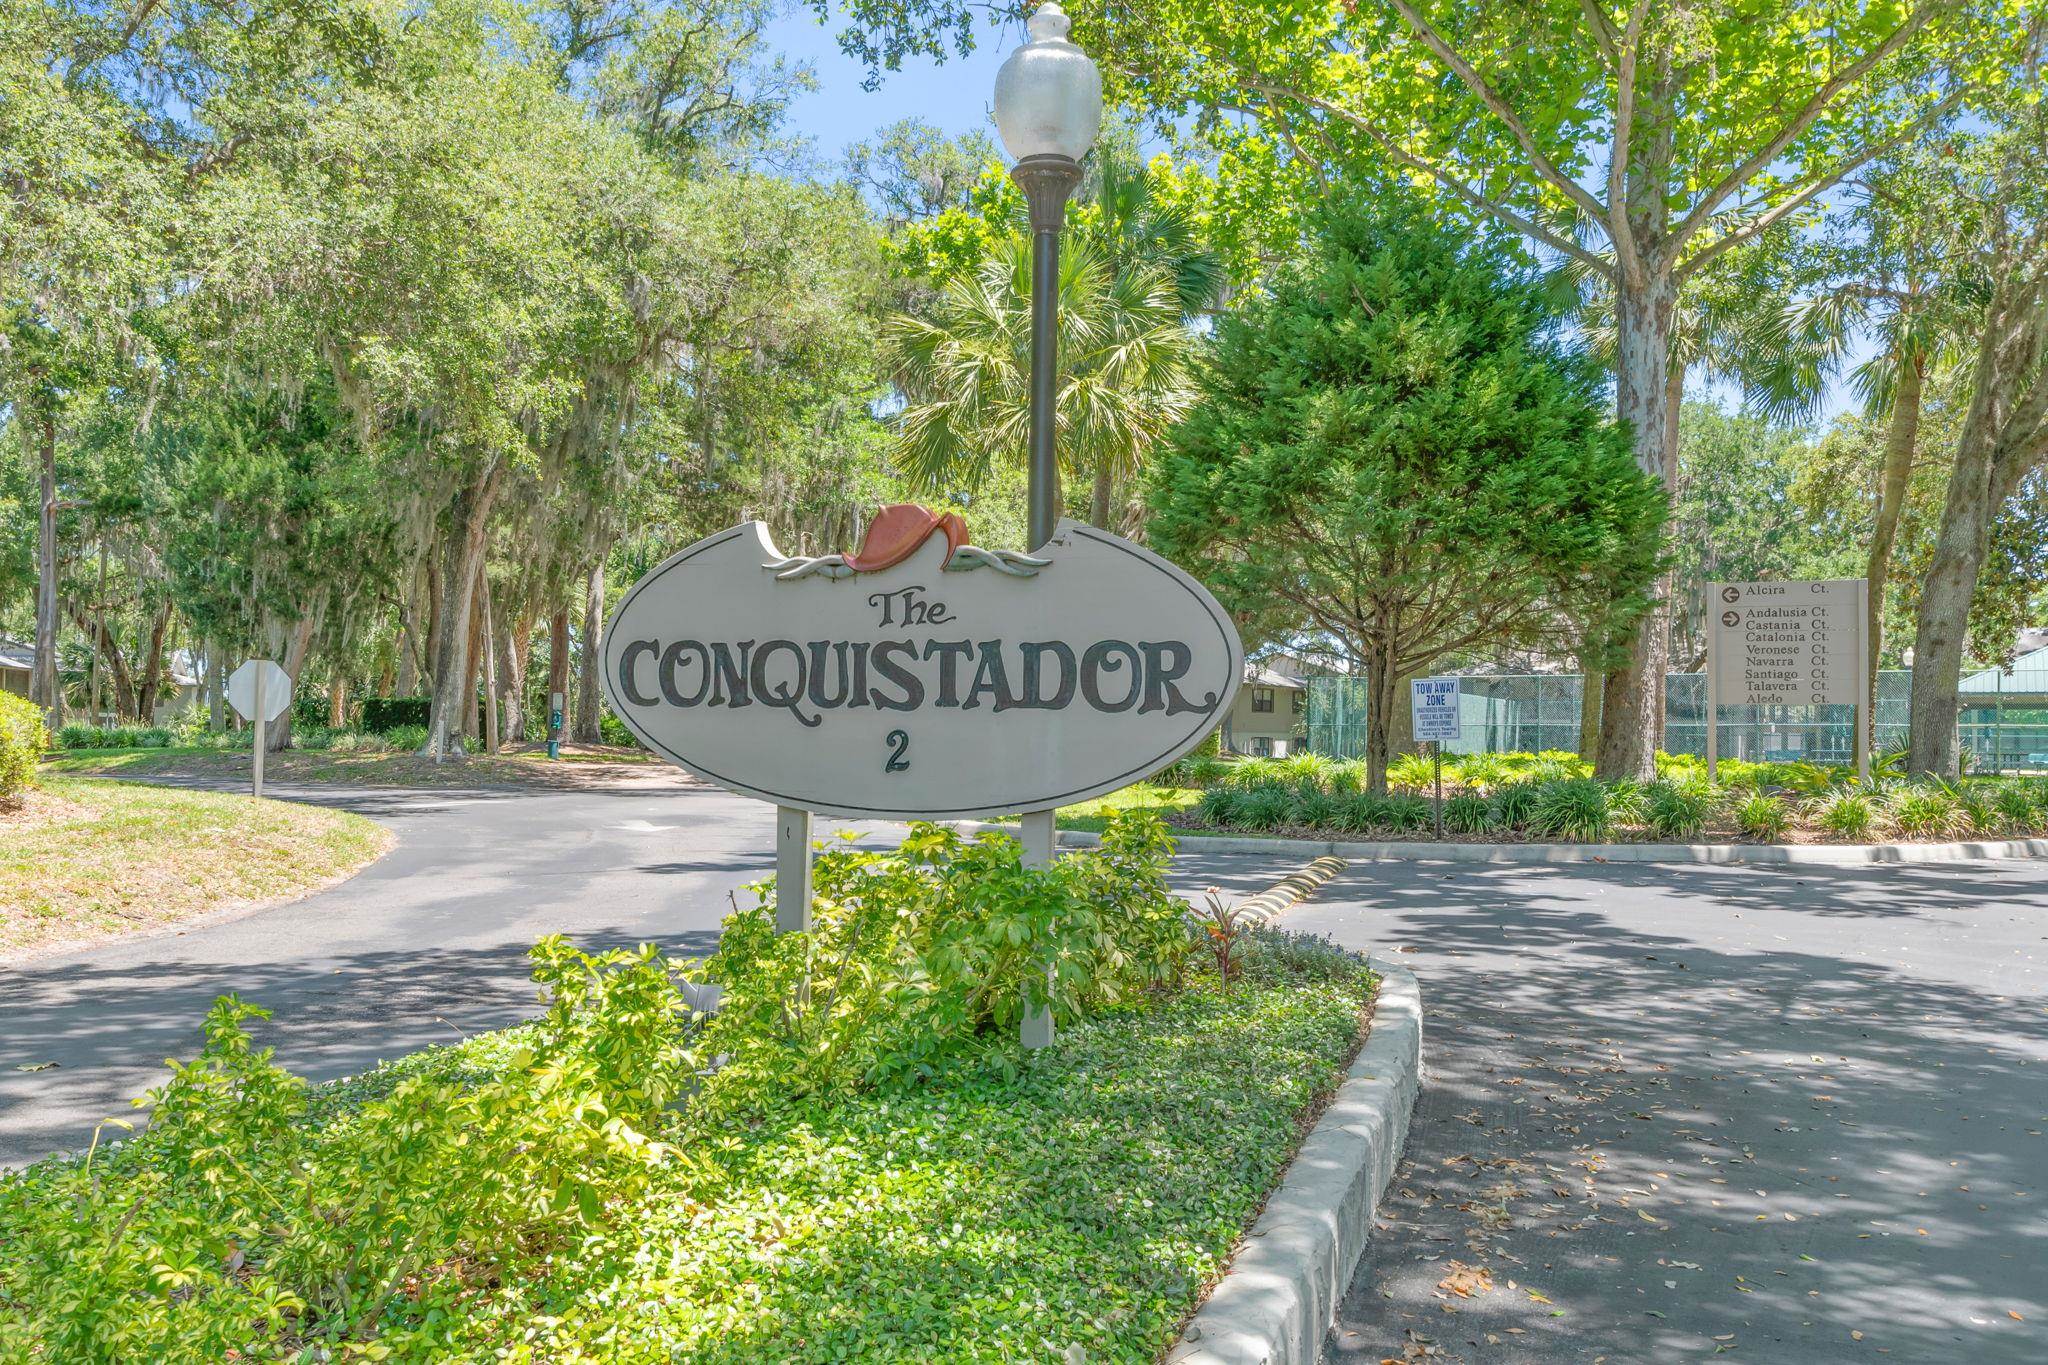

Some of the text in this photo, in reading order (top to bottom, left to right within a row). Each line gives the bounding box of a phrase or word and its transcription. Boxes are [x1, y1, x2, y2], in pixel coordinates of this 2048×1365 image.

[1746, 584, 1829, 595] Alcira Ct.
[869, 586, 957, 627] The
[1746, 607, 1829, 618] Andalusia Ct.
[1811, 620, 1829, 629] Ct.
[1746, 632, 1829, 641] Catalonia Ct.
[1746, 644, 1829, 654] Veronese Ct.
[1746, 656, 1829, 666] Navarra Ct.
[1745, 669, 1829, 681] Santiago Ct.
[619, 638, 1217, 728] CONQUISTADOR
[1416, 682, 1455, 694] TOW AWAY
[1745, 681, 1829, 691] Talavera Ct.
[1426, 694, 1446, 706] ZONE
[1746, 693, 1829, 704] Aledo Ct.
[885, 729, 910, 774] 2
